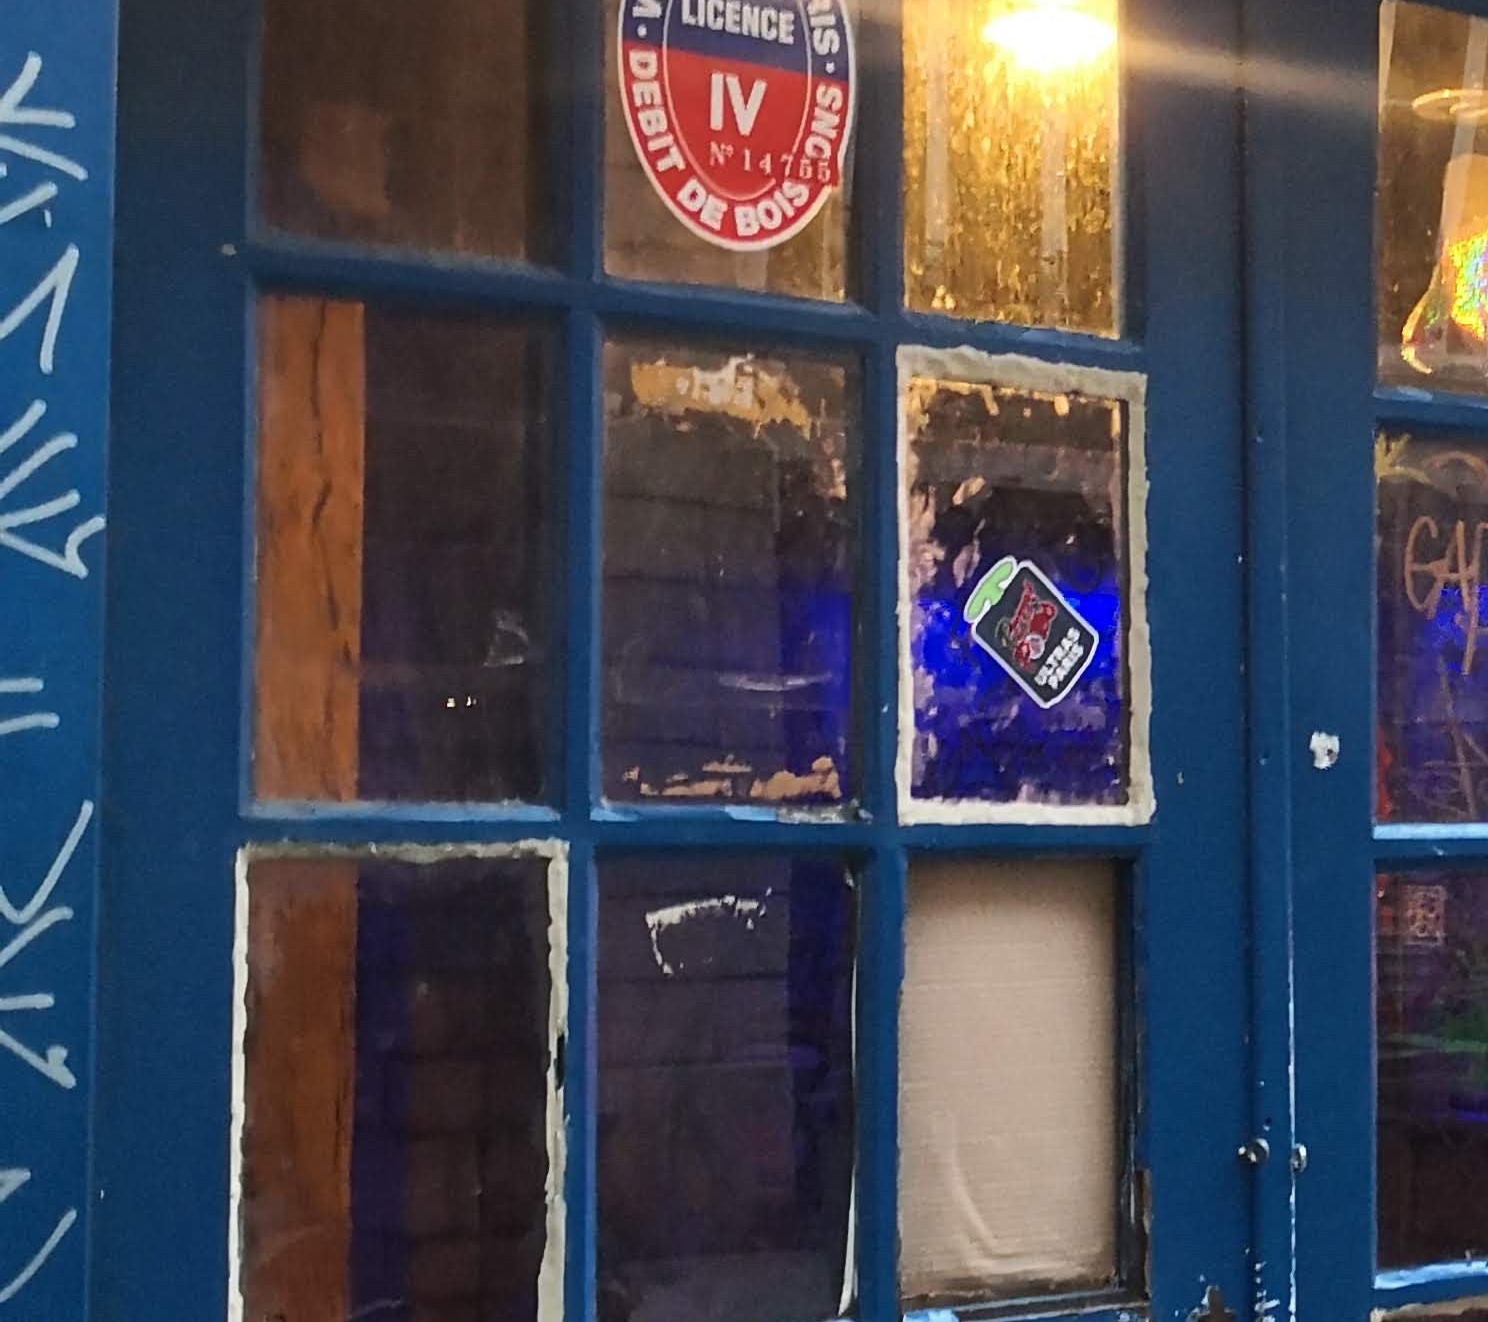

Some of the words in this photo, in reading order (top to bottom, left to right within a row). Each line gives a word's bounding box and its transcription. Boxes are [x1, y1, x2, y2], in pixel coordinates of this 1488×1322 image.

[629, 48, 685, 173] DEBIT
[676, 178, 727, 231] DE
[733, 83, 843, 238] BOISONS
[709, 71, 767, 137] IV
